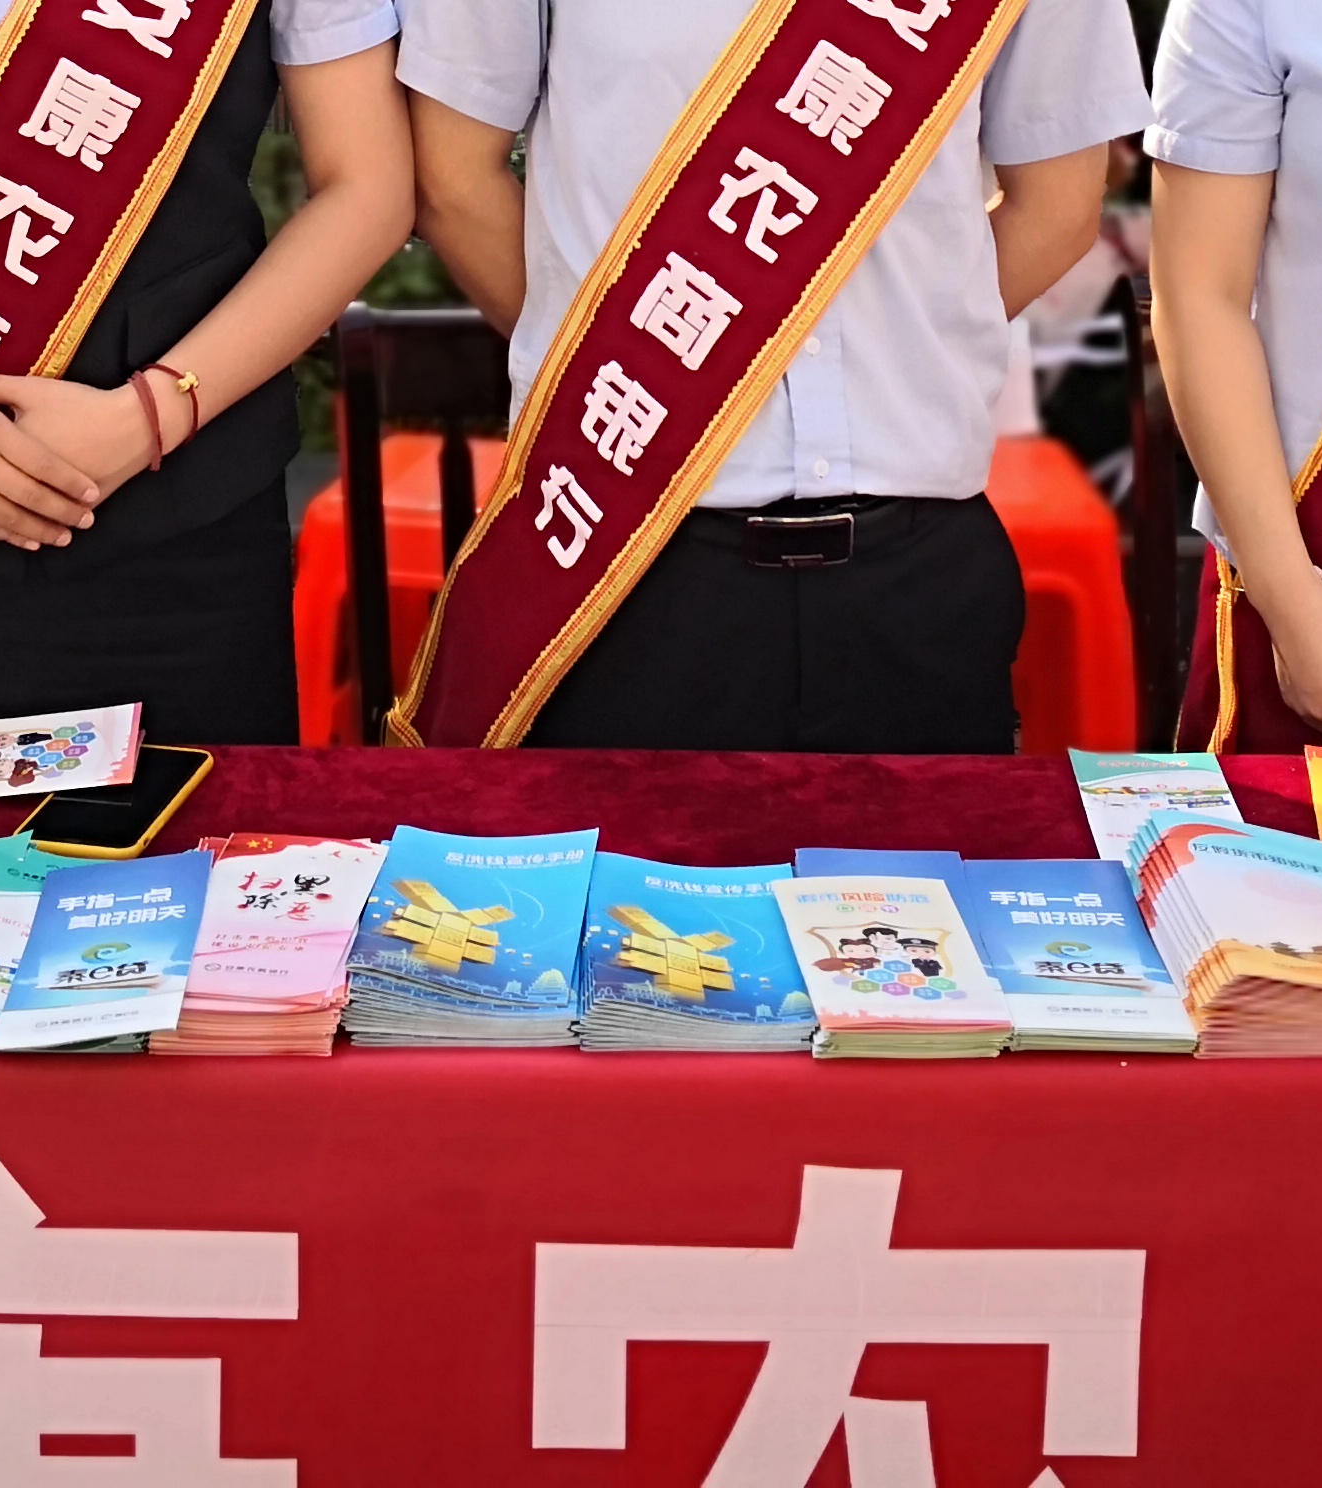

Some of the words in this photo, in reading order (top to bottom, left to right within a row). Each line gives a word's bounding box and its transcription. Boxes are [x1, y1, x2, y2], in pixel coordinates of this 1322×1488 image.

[56, 886, 173, 911] 手指一点
[990, 889, 1104, 909] 手指一点
[66, 903, 187, 930] 美好明天
[1009, 910, 1126, 928] 美好明天
